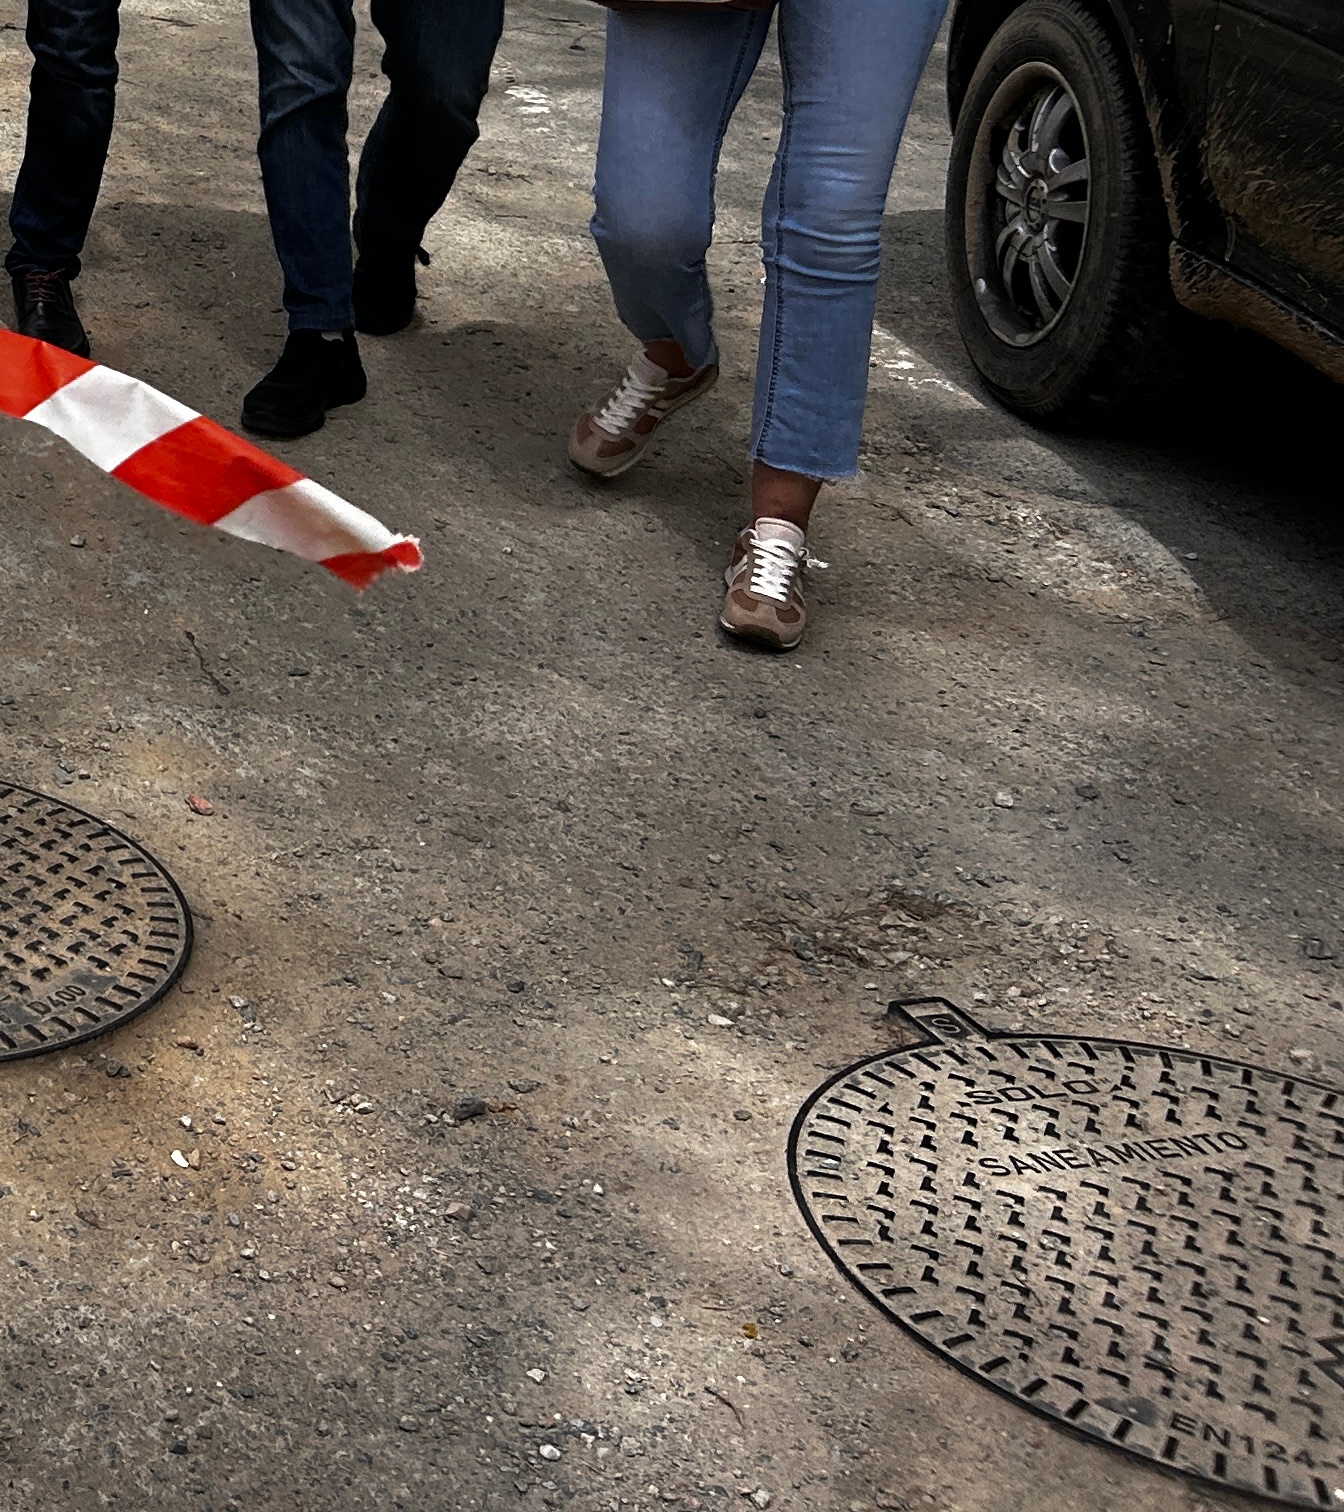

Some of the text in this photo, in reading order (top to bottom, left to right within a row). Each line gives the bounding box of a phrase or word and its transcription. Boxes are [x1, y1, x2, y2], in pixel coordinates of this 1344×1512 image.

[25, 984, 87, 1016] D400
[932, 1017, 961, 1034] S
[963, 1078, 1100, 1105] SOLO
[978, 1130, 1248, 1177] SANEAMIENTO
[1170, 1410, 1344, 1471] EN124-
